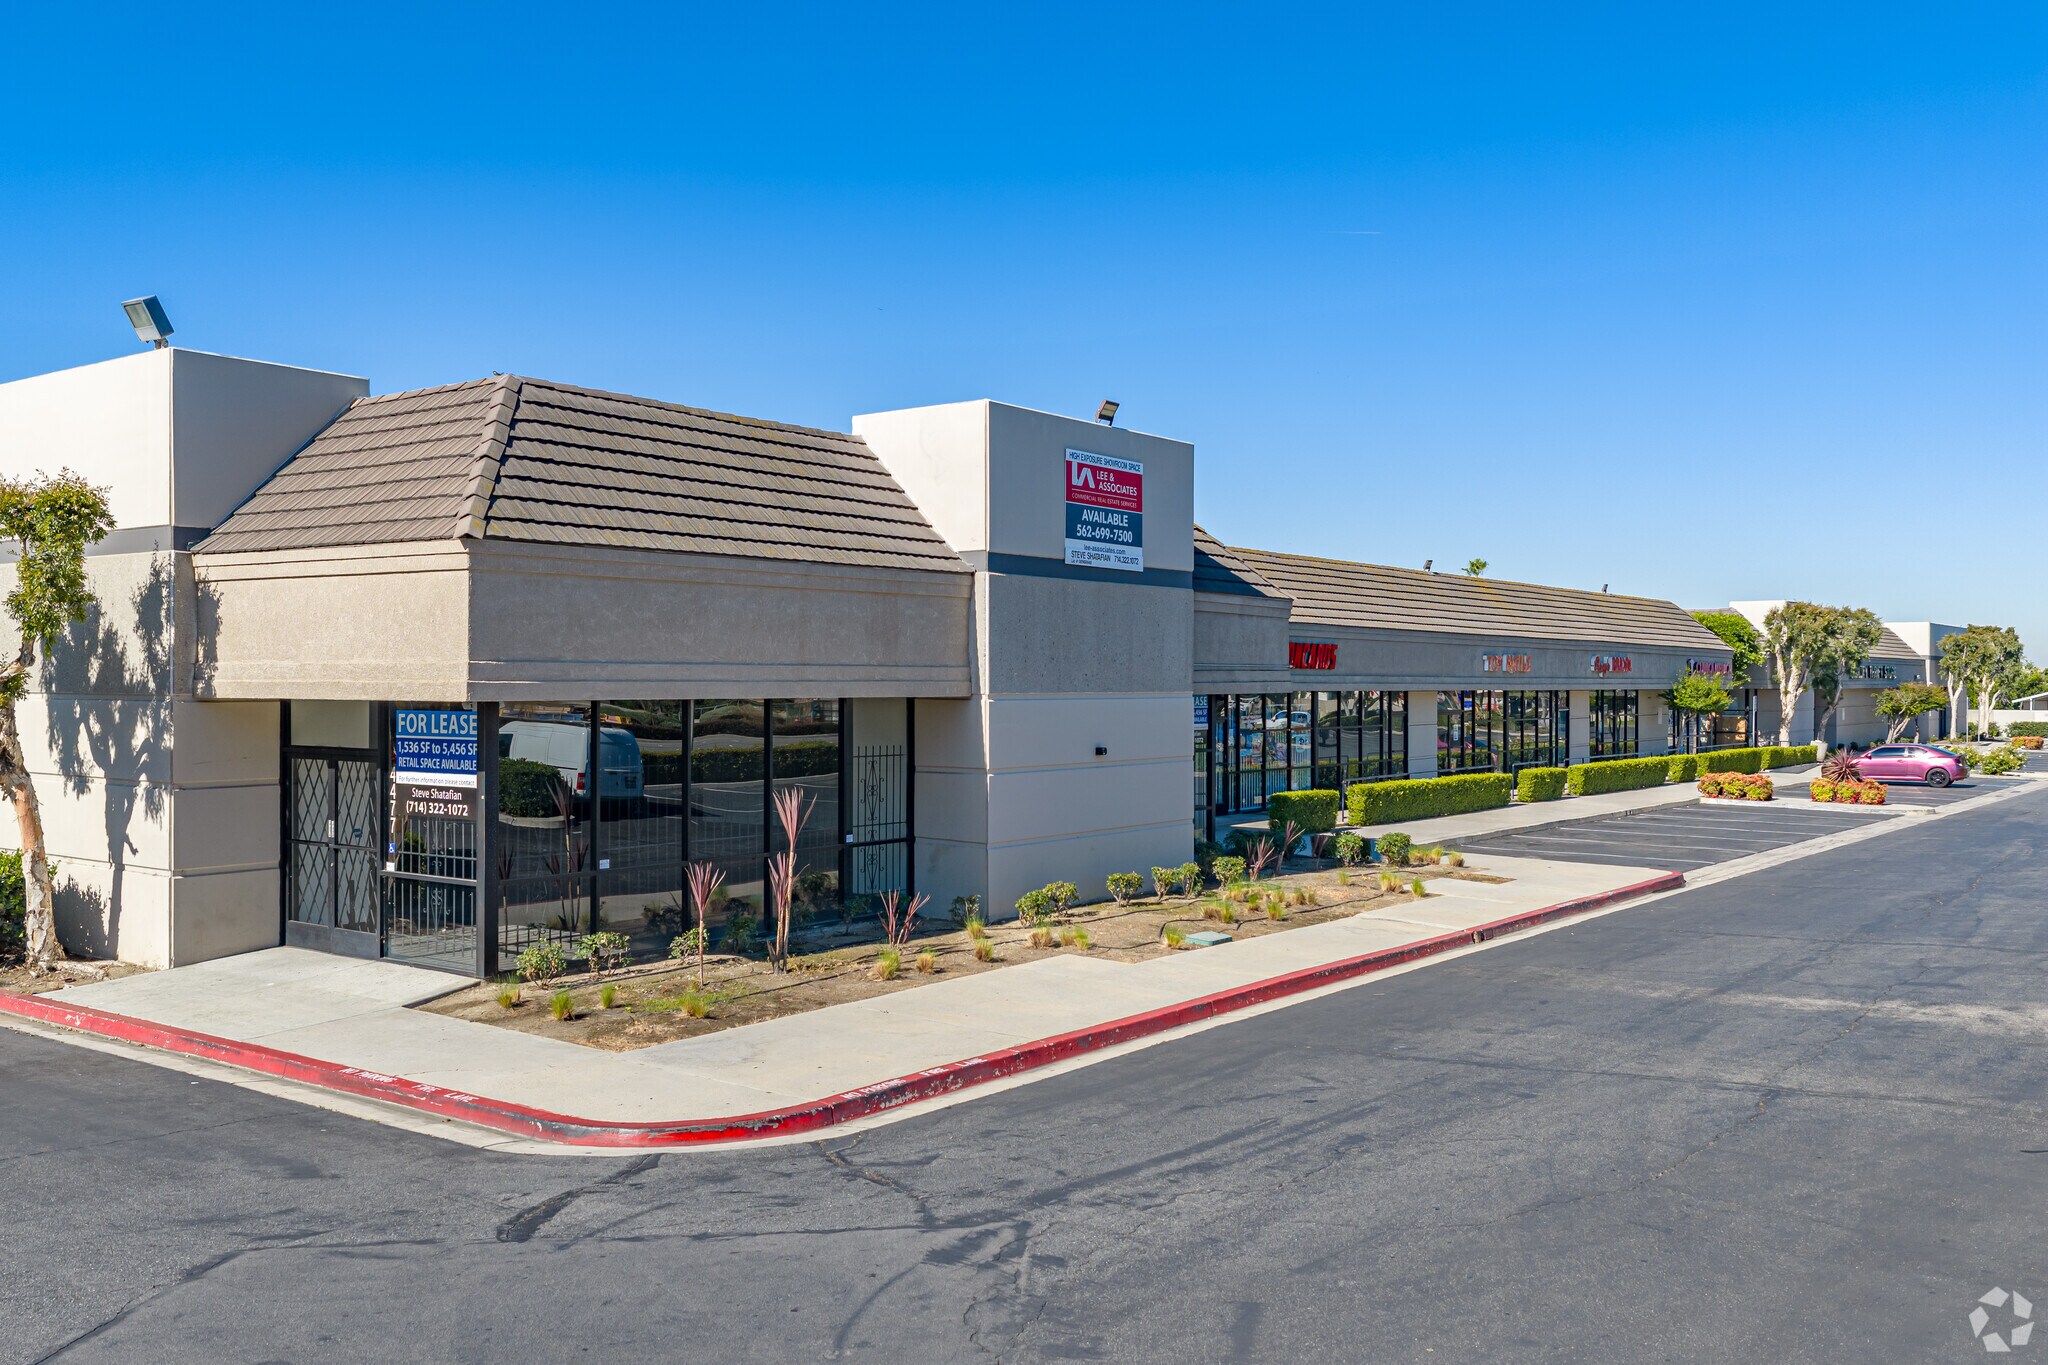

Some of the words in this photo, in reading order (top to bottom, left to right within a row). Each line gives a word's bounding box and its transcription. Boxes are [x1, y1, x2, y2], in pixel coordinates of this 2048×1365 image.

[1081, 453, 1102, 465] EXPOSURE
[1104, 457, 1128, 469] SHOWROOM
[1128, 463, 1141, 472] SPACE
[1096, 470, 1108, 480] LEE
[1110, 472, 1114, 482] &
[1098, 482, 1138, 496] ASSOCIATES
[1082, 509, 1128, 526] AVAILABLE
[1076, 524, 1132, 542] 562-699-7500
[1071, 550, 1086, 560] STEVE
[1084, 544, 1126, 554] lee-associates.com
[398, 714, 427, 734] FOR
[432, 714, 477, 734] LEASE
[398, 741, 419, 754] 1,536
[420, 742, 430, 754] SF
[432, 744, 440, 754] to
[442, 743, 466, 756] 5,456
[468, 744, 477, 756] SF
[398, 758, 419, 768] RETAIL
[420, 758, 440, 768] SPACE
[441, 760, 476, 770] AVAILABLE
[412, 788, 430, 798] Steve
[432, 789, 462, 800] Shatafian
[406, 800, 427, 814] (714)
[428, 802, 468, 816] 322-1072
[860, 1078, 906, 1093] PARKING
[956, 1058, 988, 1066] LANE
[356, 1071, 398, 1082] PARKING
[412, 1083, 441, 1093] FIRE
[444, 1092, 479, 1102] LANE
